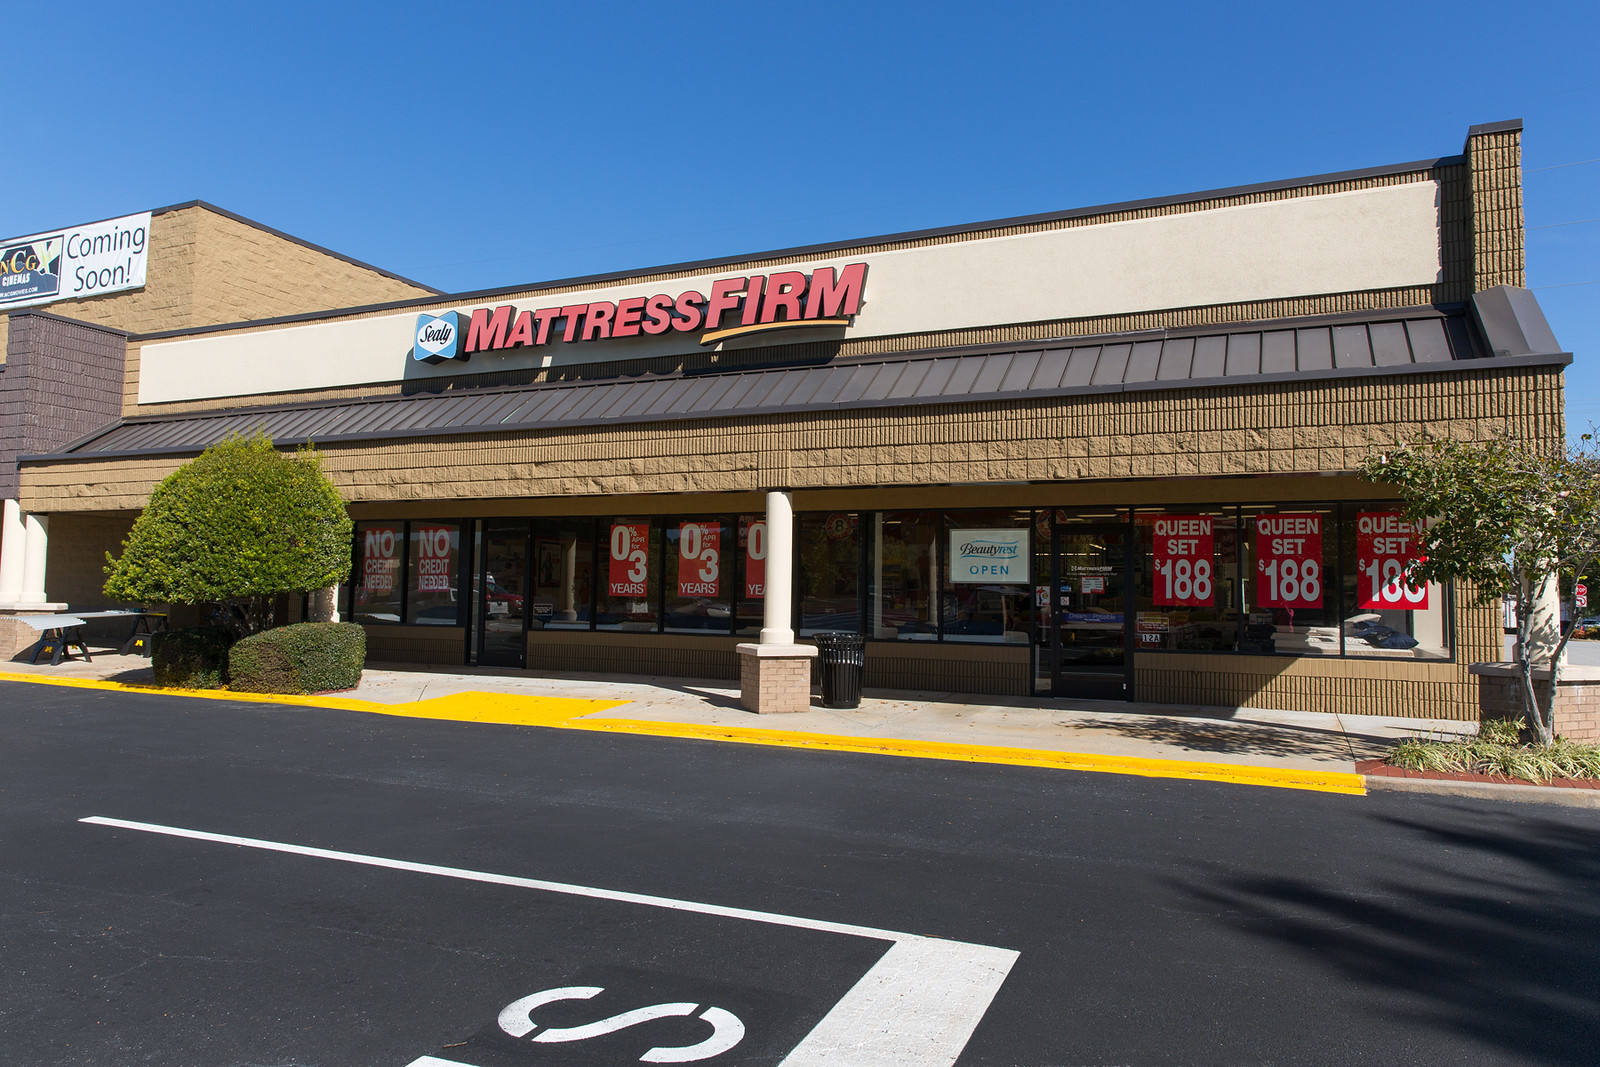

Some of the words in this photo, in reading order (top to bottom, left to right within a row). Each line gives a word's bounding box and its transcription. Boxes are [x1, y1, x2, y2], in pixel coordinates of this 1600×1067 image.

[67, 226, 145, 259] Coming
[74, 257, 132, 292] Soon!
[420, 323, 452, 345] Sealy
[1155, 519, 1211, 536] QUEEN
[1258, 518, 1318, 535] QUEEN
[365, 529, 395, 558] NO
[419, 529, 450, 558] NO
[960, 541, 1018, 556] Beautyrest
[1167, 539, 1199, 555] SET
[1271, 538, 1306, 555] SET
[1373, 537, 1409, 555] SET
[365, 559, 393, 573] CREDIT
[419, 559, 449, 574] CREDIT
[627, 550, 647, 583] 3
[699, 549, 719, 583] 3
[969, 565, 1009, 575] OPEN
[365, 575, 393, 589] NEEDED
[418, 575, 449, 590] NEEDED
[1154, 558, 1213, 600] $188
[1258, 558, 1320, 602] $188
[611, 583, 644, 594] YEARS
[680, 583, 716, 594] YEARS
